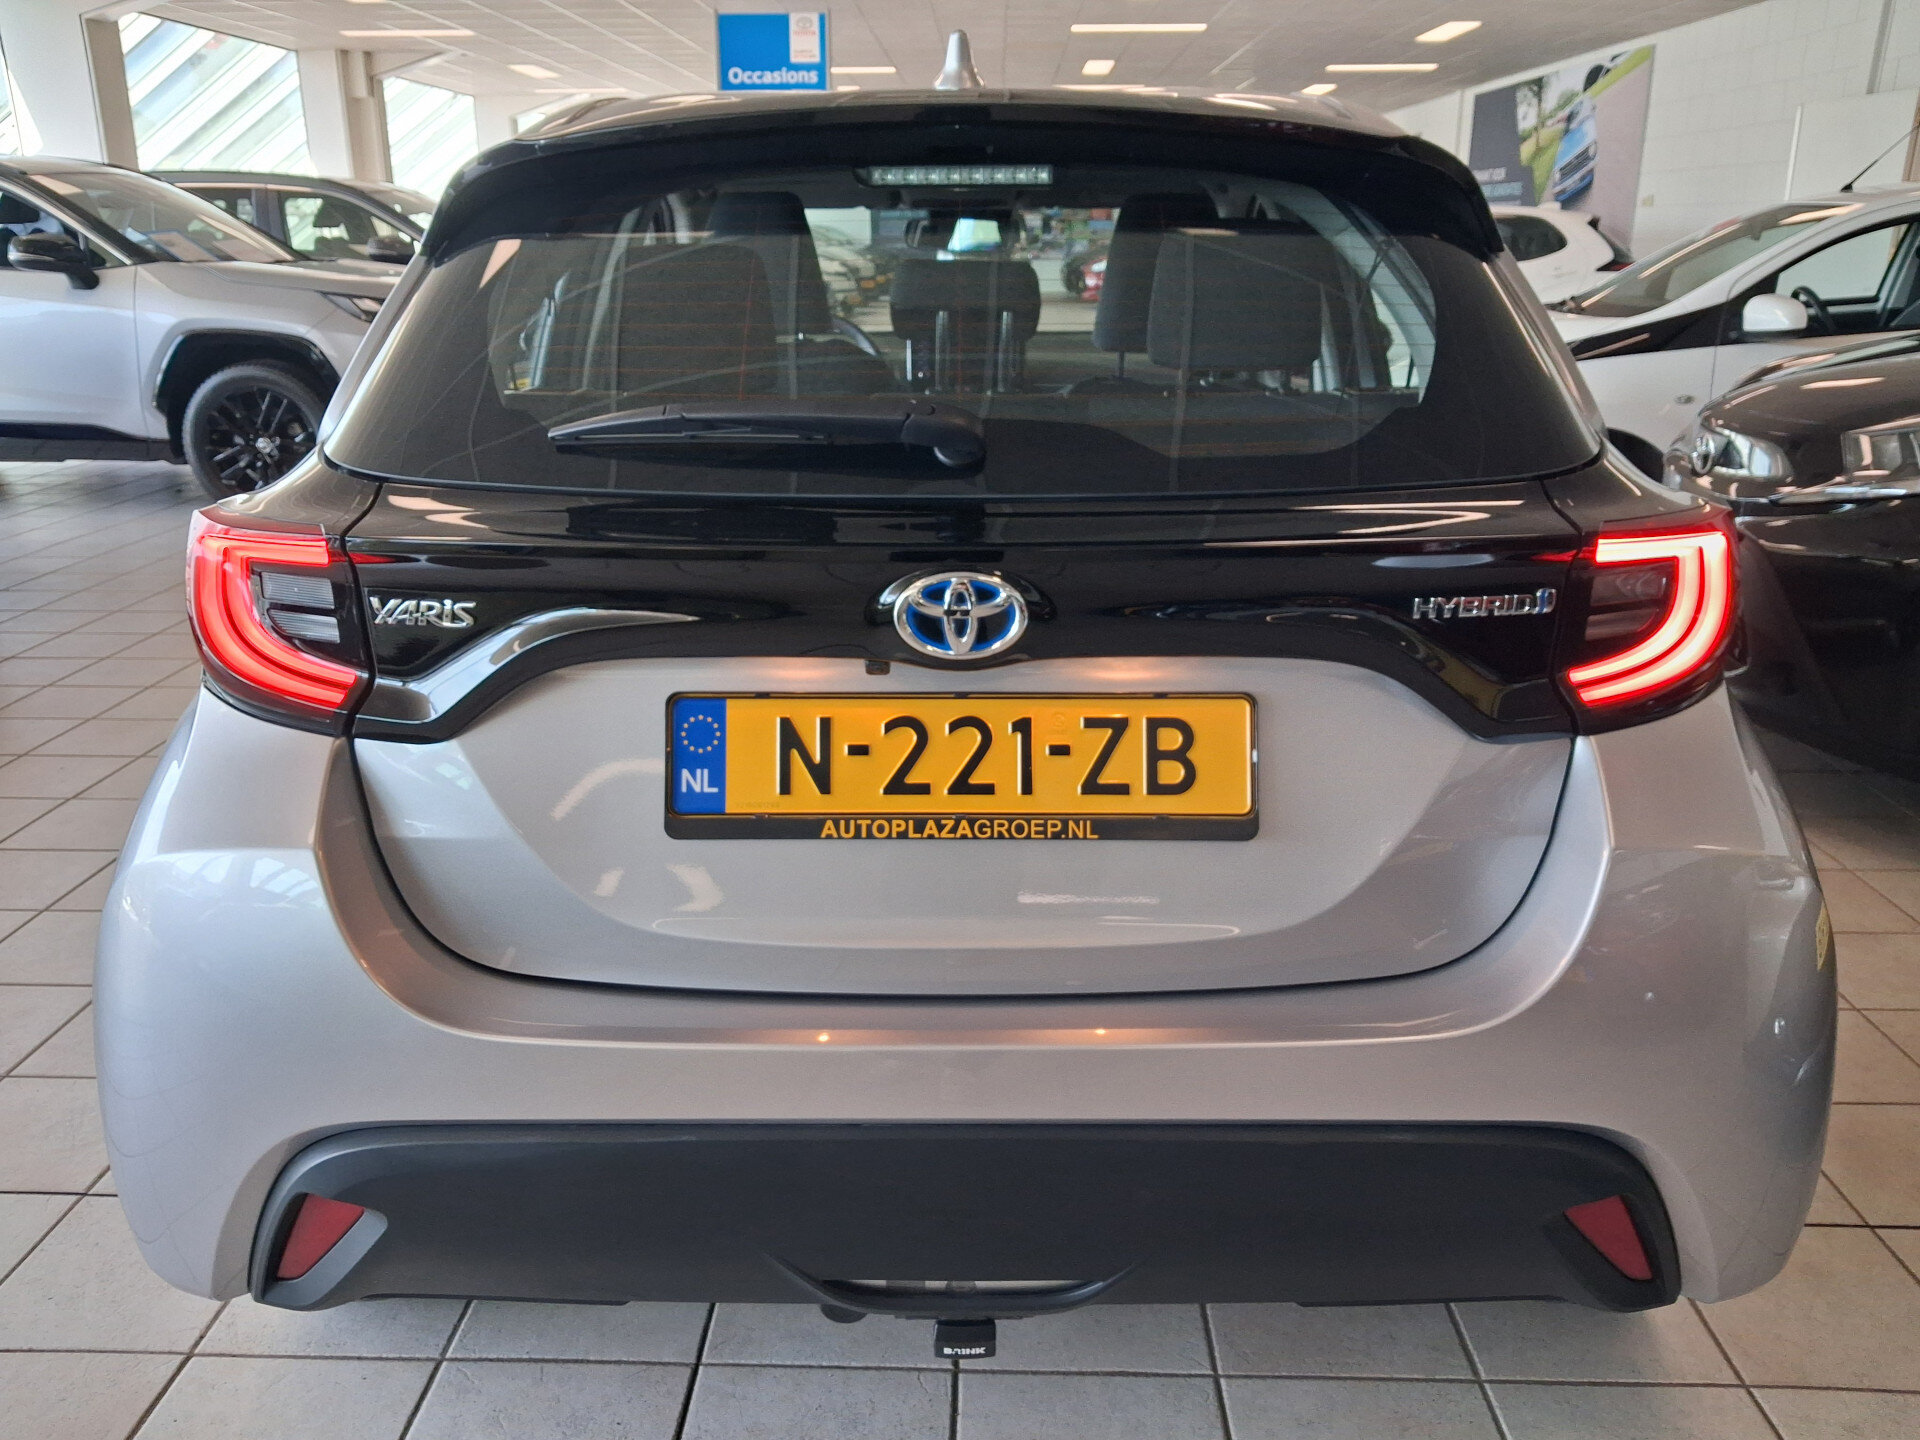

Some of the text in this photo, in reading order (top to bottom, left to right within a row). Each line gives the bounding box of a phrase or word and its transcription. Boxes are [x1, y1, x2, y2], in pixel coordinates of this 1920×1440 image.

[727, 66, 819, 85] Occasions
[1412, 594, 1535, 619] HYBRID
[776, 715, 1197, 796] N-221-ZB
[681, 768, 719, 793] NL
[819, 819, 1099, 839] AUTOPLAZAGROEP.NL
